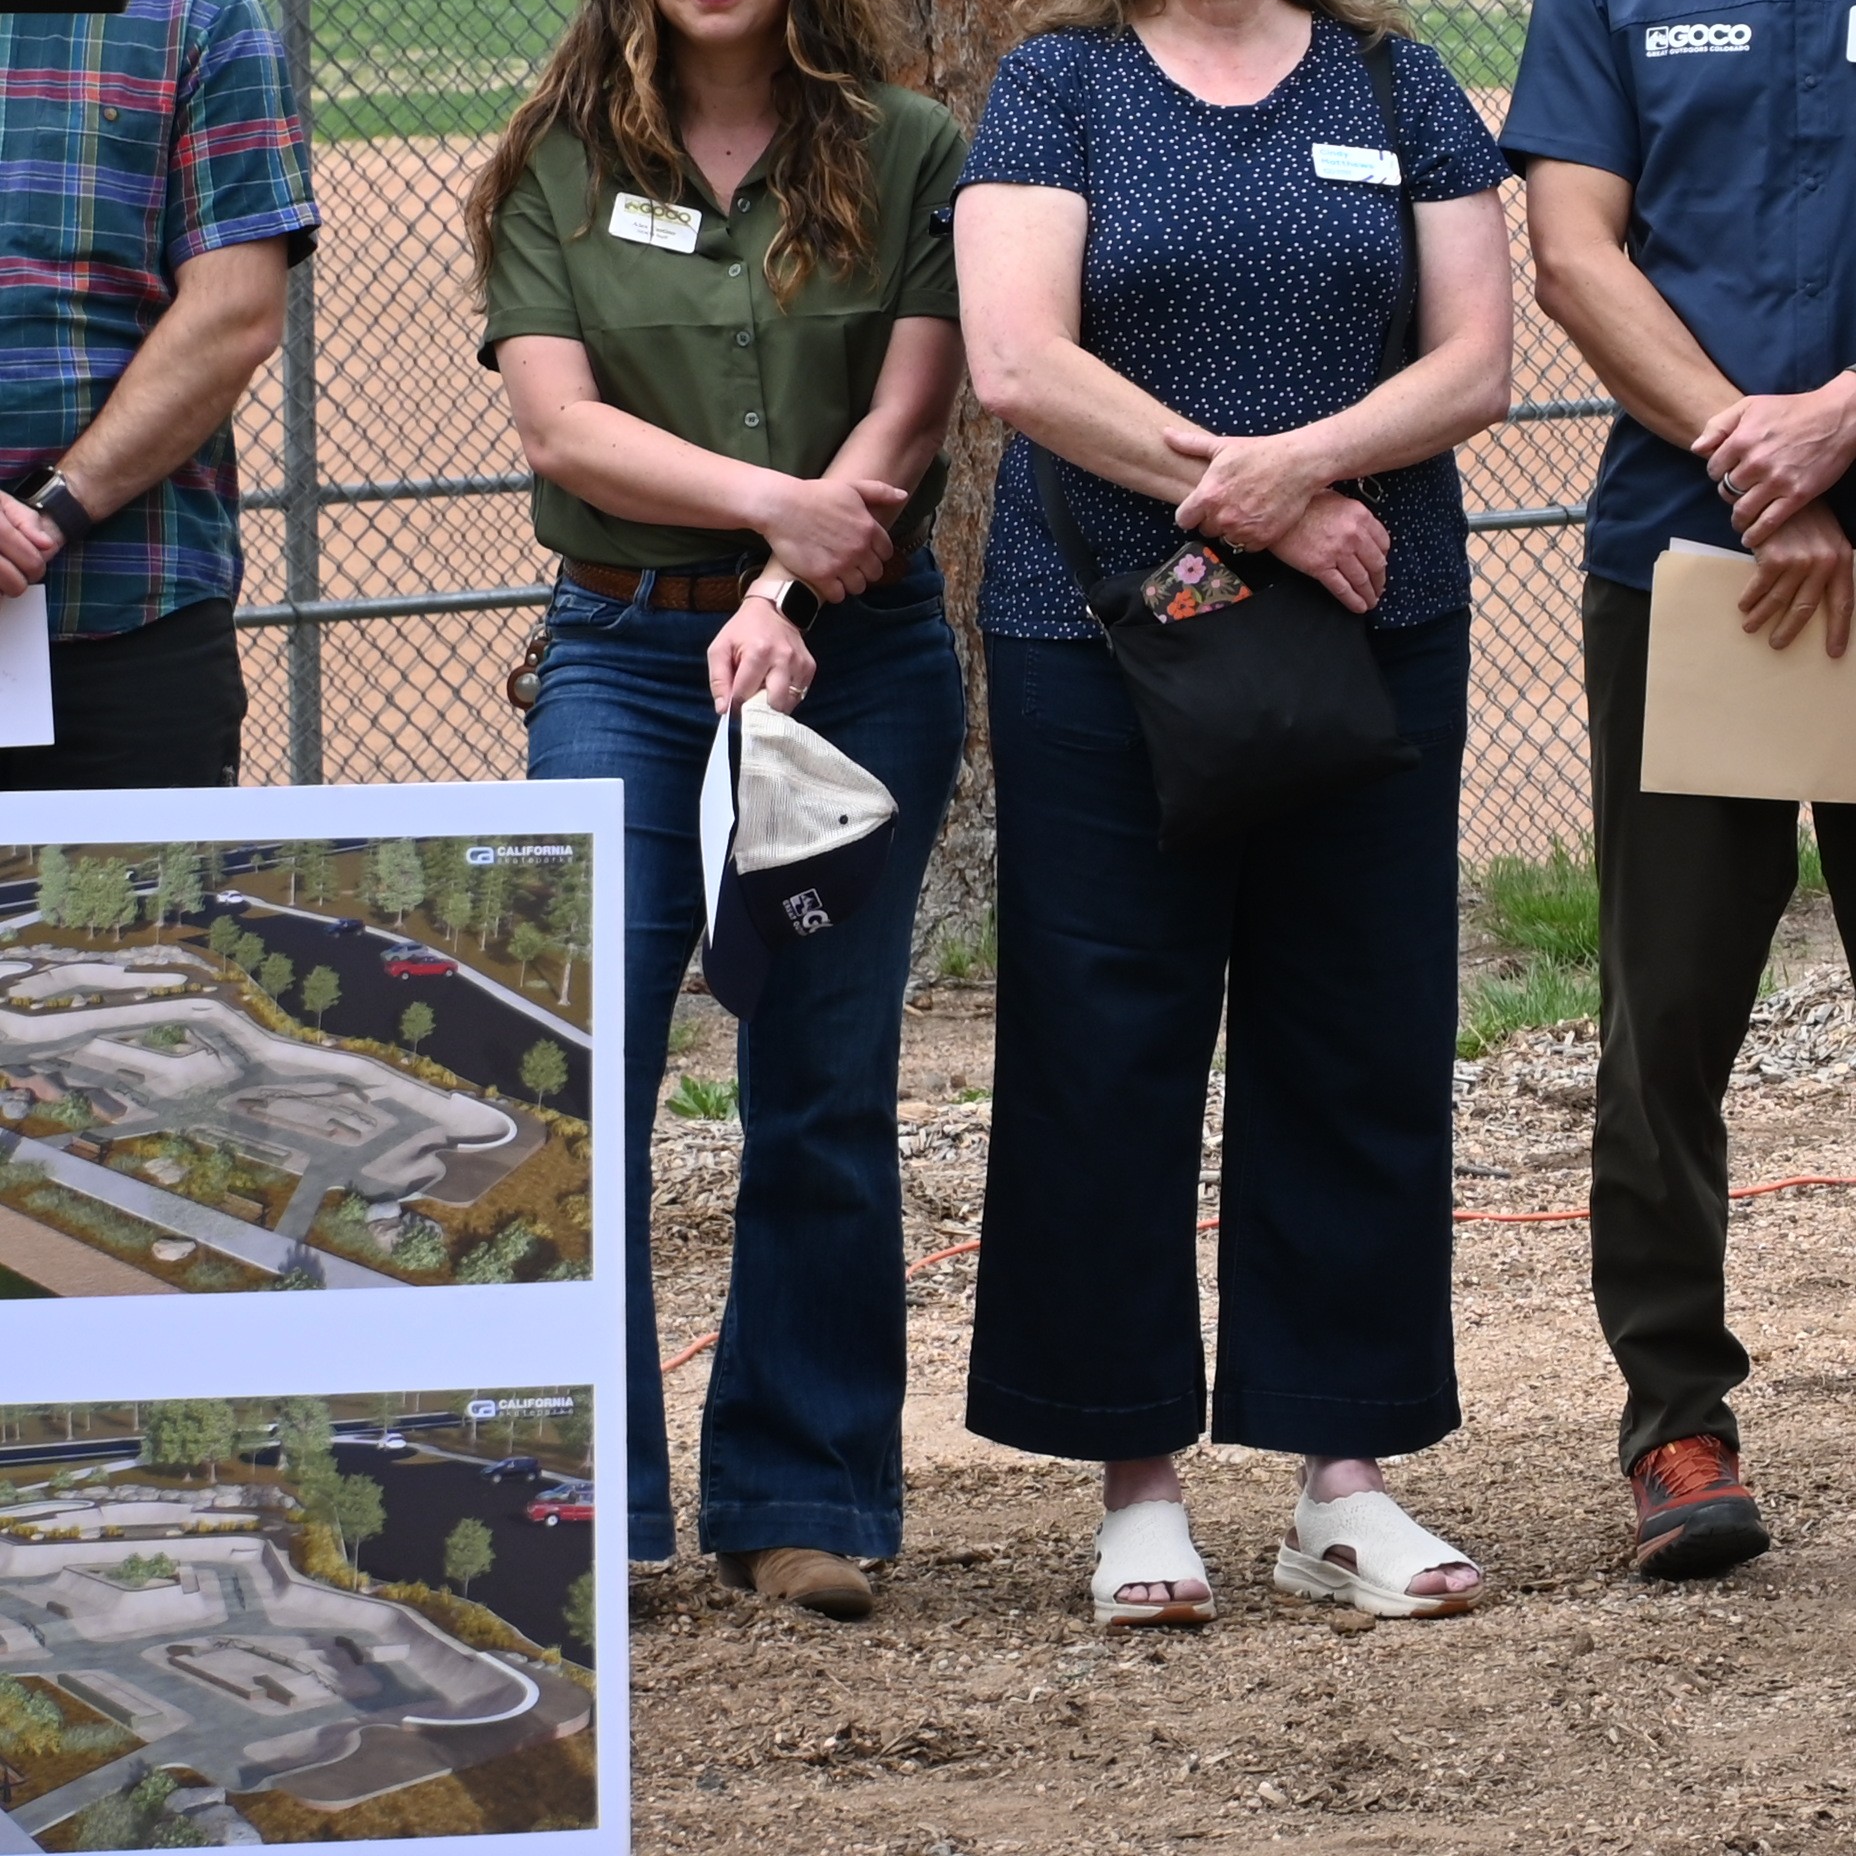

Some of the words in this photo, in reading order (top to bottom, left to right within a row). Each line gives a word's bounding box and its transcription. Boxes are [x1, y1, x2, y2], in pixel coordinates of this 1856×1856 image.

[1668, 24, 1752, 48] GOCO
[1669, 46, 1708, 55] OUTDOORS
[498, 845, 573, 856] CALIFORNIA
[499, 1397, 574, 1409] CALIFORNIA
